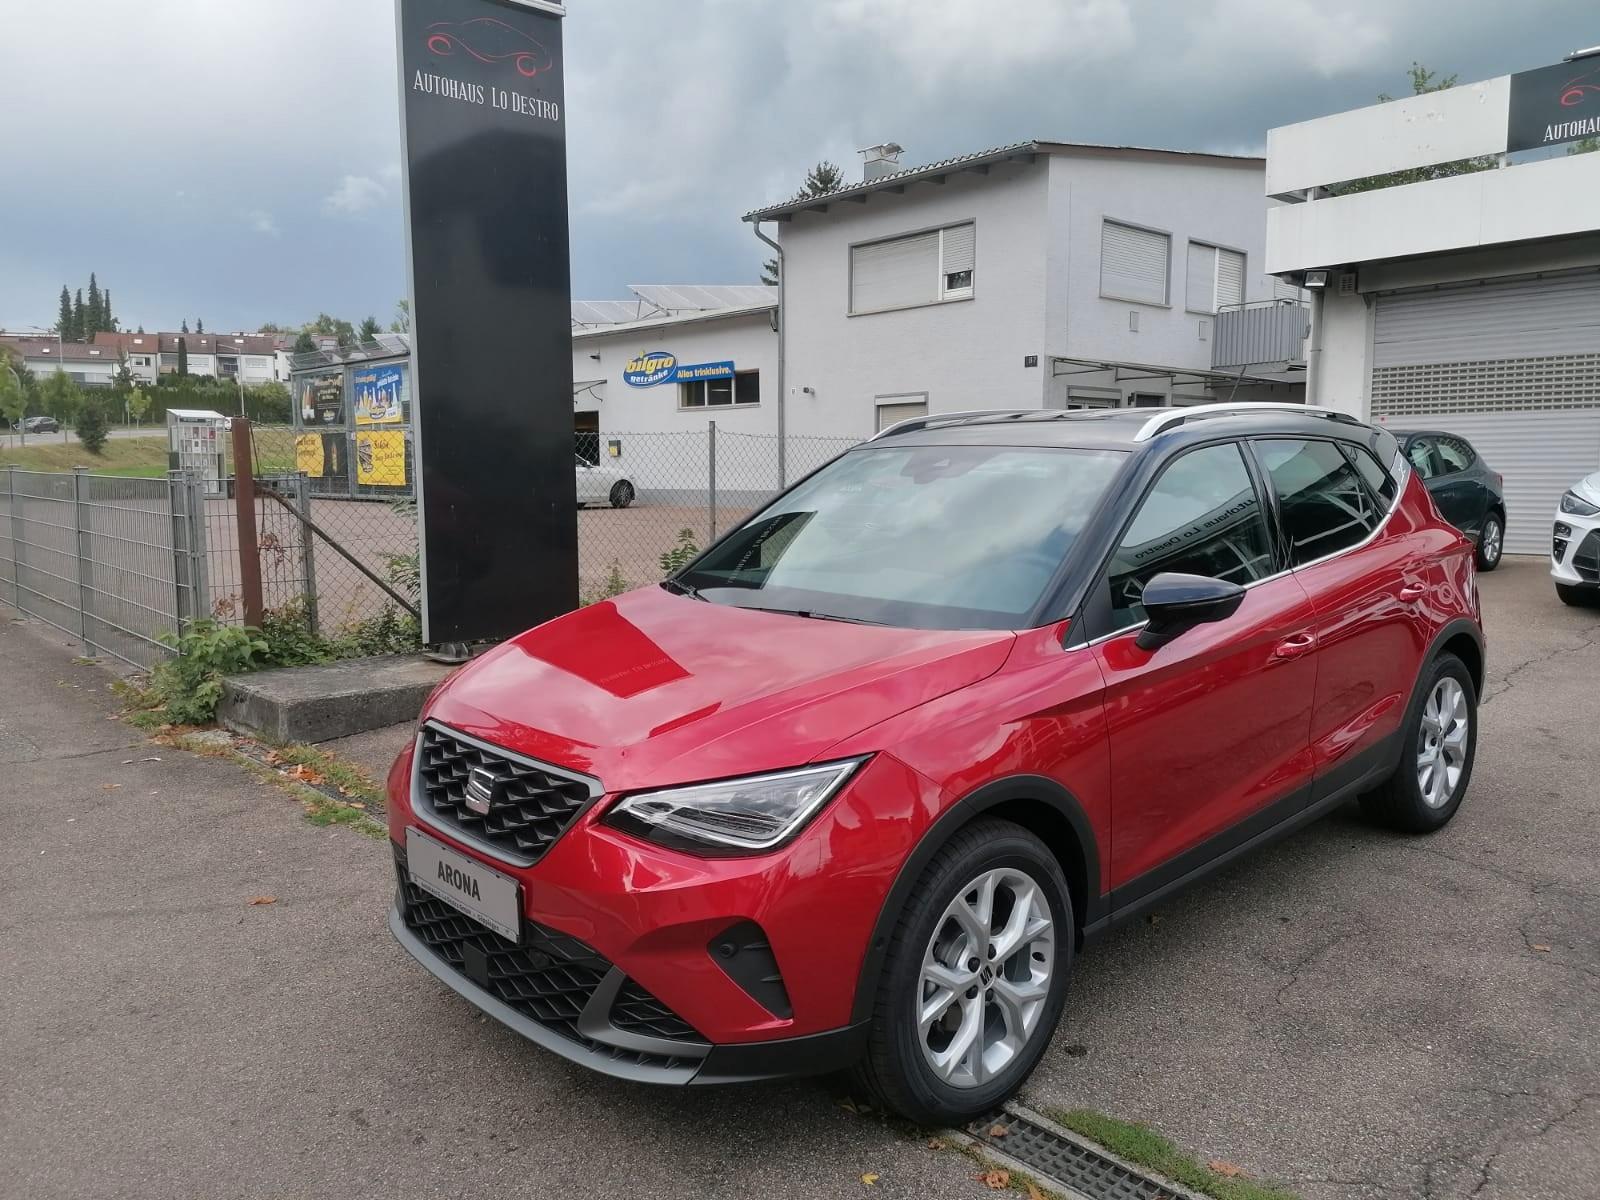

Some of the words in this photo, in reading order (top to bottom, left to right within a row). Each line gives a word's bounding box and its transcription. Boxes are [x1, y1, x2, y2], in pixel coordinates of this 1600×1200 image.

[413, 69, 485, 105] AUTOHAUS
[492, 87, 508, 110] LO
[512, 92, 559, 121] DESTRO
[625, 351, 674, 374] bilgro
[677, 370, 694, 379] Alles
[437, 860, 481, 902] ARONA
